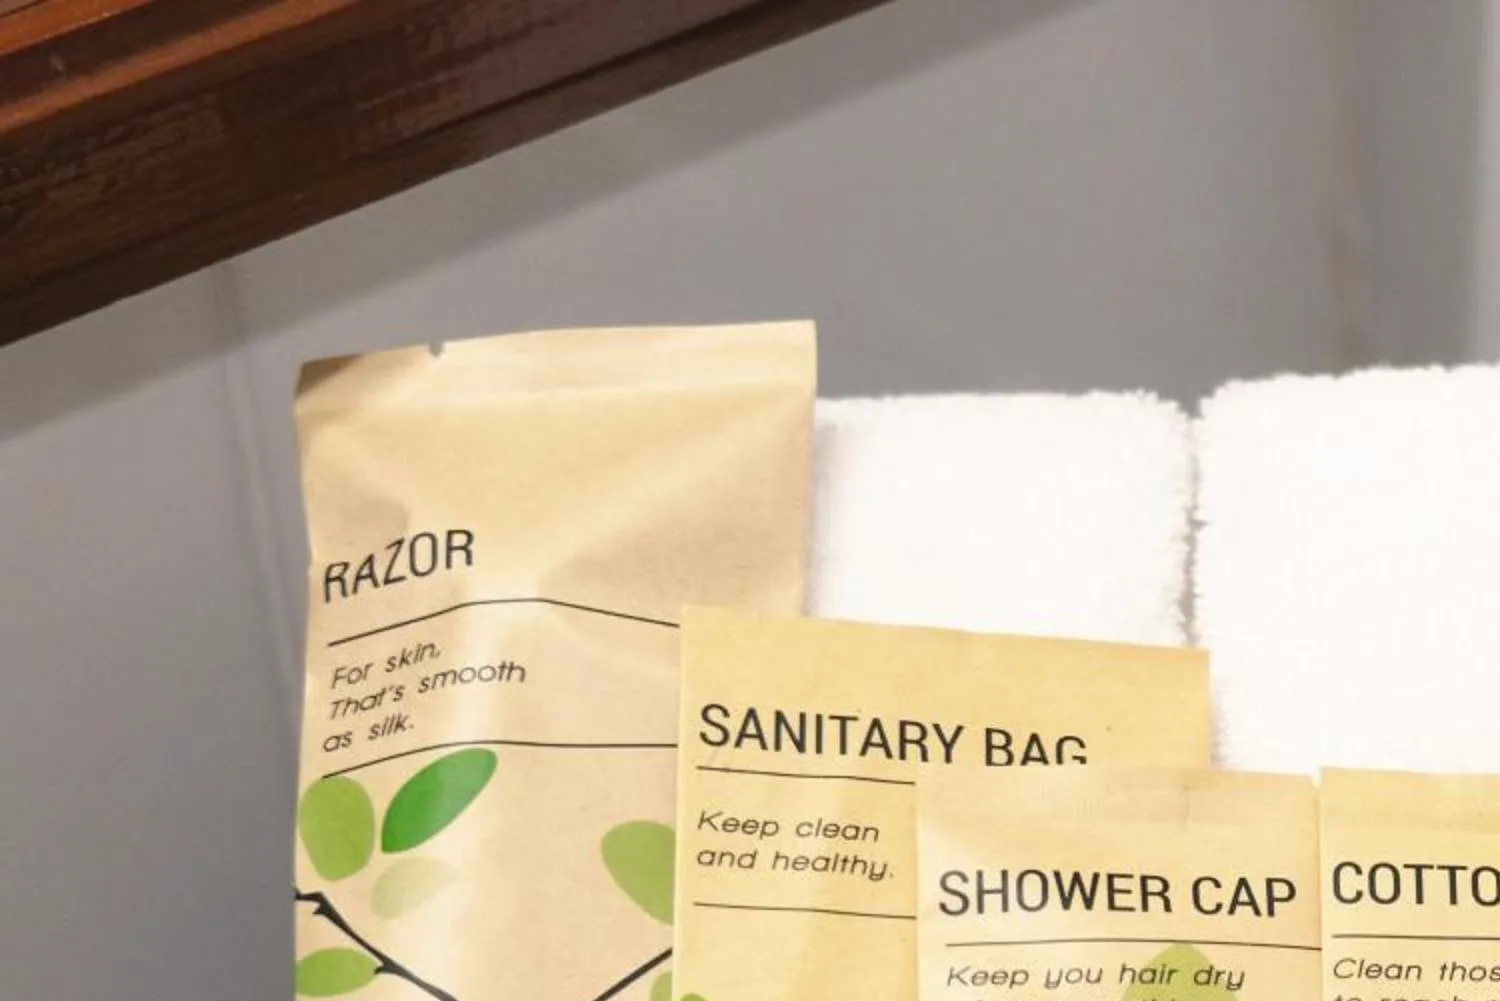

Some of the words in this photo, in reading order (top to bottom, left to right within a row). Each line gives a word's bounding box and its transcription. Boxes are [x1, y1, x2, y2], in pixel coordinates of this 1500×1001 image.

[323, 528, 475, 602] RAZOR
[331, 663, 374, 689] For
[331, 680, 405, 722] That's
[418, 660, 526, 693] smooth
[323, 731, 352, 752] as
[368, 713, 414, 740] silk.
[699, 703, 964, 764] SANITARY
[985, 728, 1086, 766] BAG
[698, 811, 780, 840] Keep
[796, 818, 879, 842] clean
[697, 850, 758, 869] and
[772, 850, 894, 882] healthy.
[939, 869, 1172, 916] SHOWER
[1192, 876, 1296, 917] CAP
[947, 967, 1029, 989] Keep
[1044, 968, 1103, 990] you
[1119, 963, 1178, 984] hair
[1194, 965, 1245, 991] dry
[1333, 958, 1422, 981] Clean
